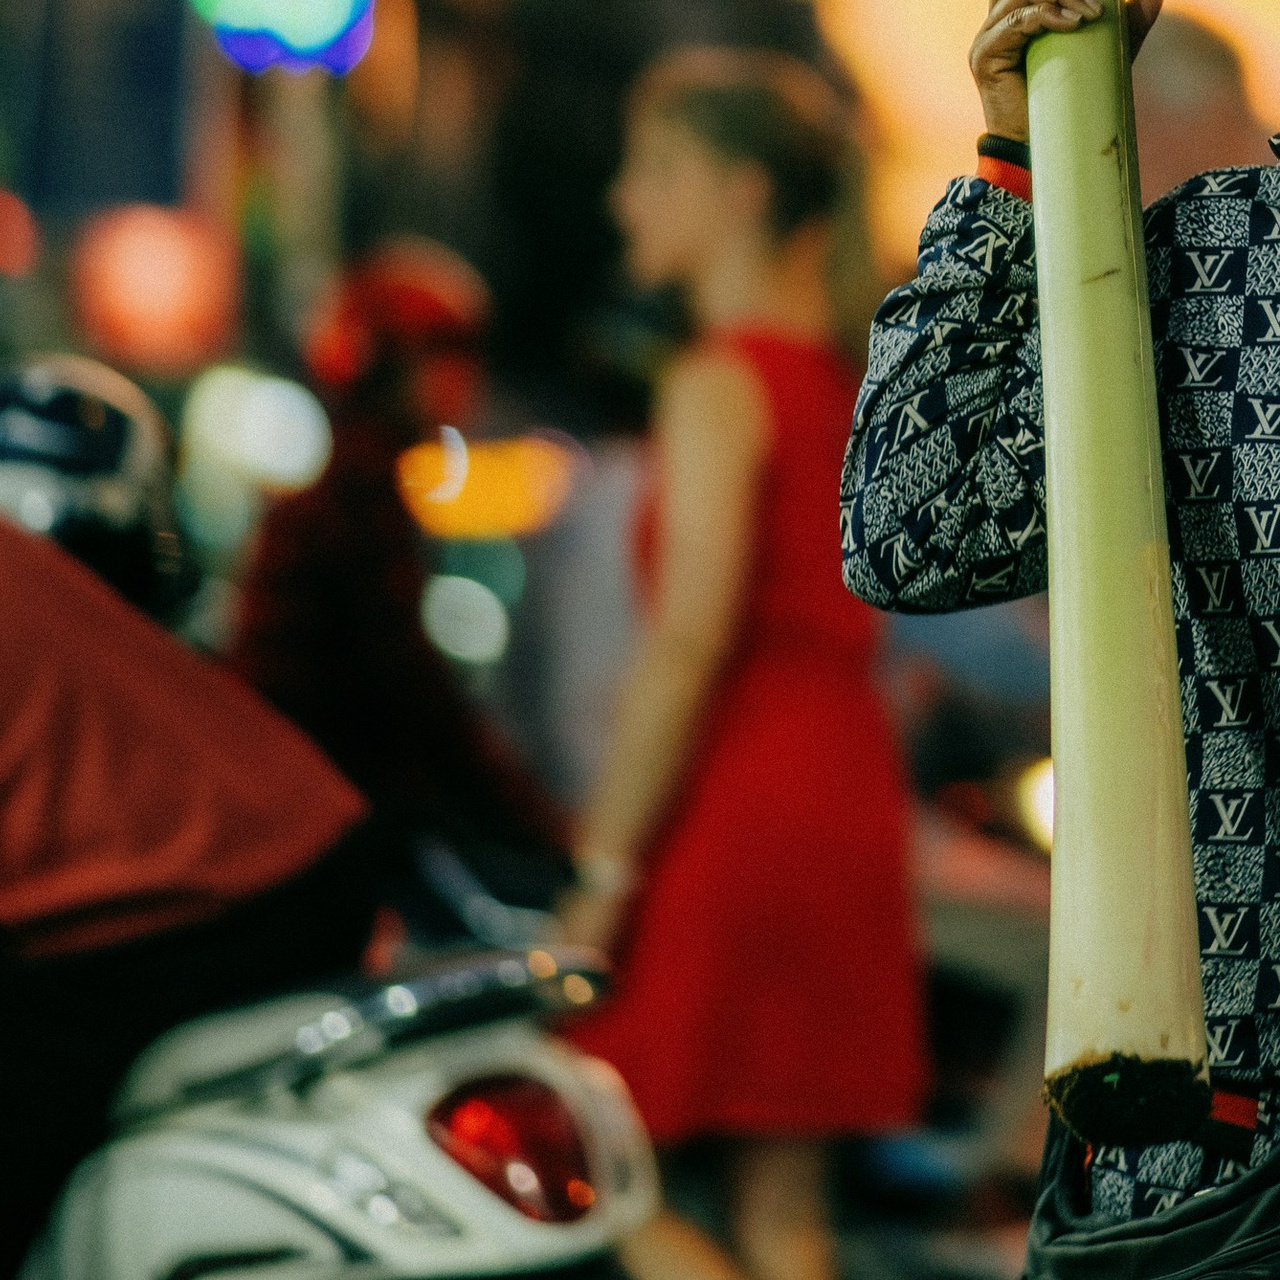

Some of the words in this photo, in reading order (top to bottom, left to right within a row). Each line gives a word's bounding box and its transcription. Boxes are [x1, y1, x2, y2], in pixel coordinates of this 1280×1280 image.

[1194, 174, 1248, 196] LV
[1185, 251, 1234, 292] LV
[1177, 347, 1226, 387] LV
[888, 389, 931, 454] LV
[1179, 452, 1221, 500] LV
[1196, 566, 1235, 612] LV
[1206, 679, 1252, 727] LV
[1208, 793, 1254, 840] LV
[1201, 907, 1249, 955] LV
